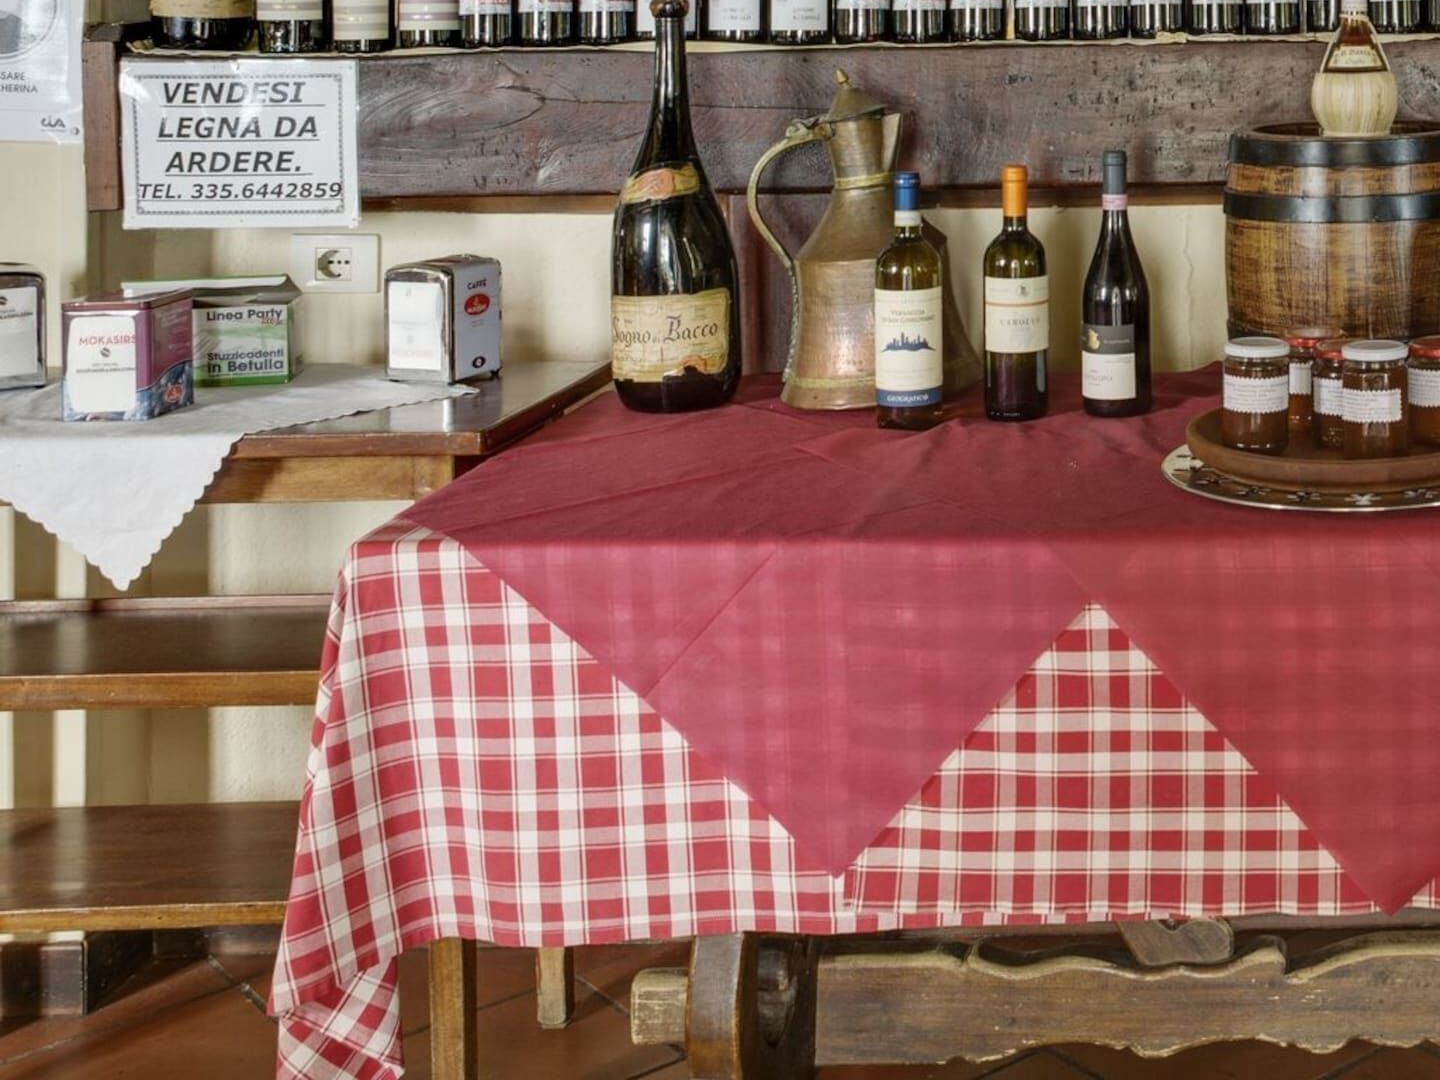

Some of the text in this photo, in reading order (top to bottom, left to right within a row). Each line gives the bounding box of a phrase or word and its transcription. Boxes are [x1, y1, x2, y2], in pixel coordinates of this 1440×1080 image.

[163, 81, 306, 104] VENDESI
[158, 116, 318, 139] LEGNA DA
[165, 151, 301, 174] ARDERE.
[139, 182, 342, 199] TEL. 335.6442859
[207, 308, 283, 322] Linea Party
[663, 314, 718, 342] Bacco
[208, 349, 284, 362] Stuzzicadenti
[208, 359, 284, 374] in Betulla
